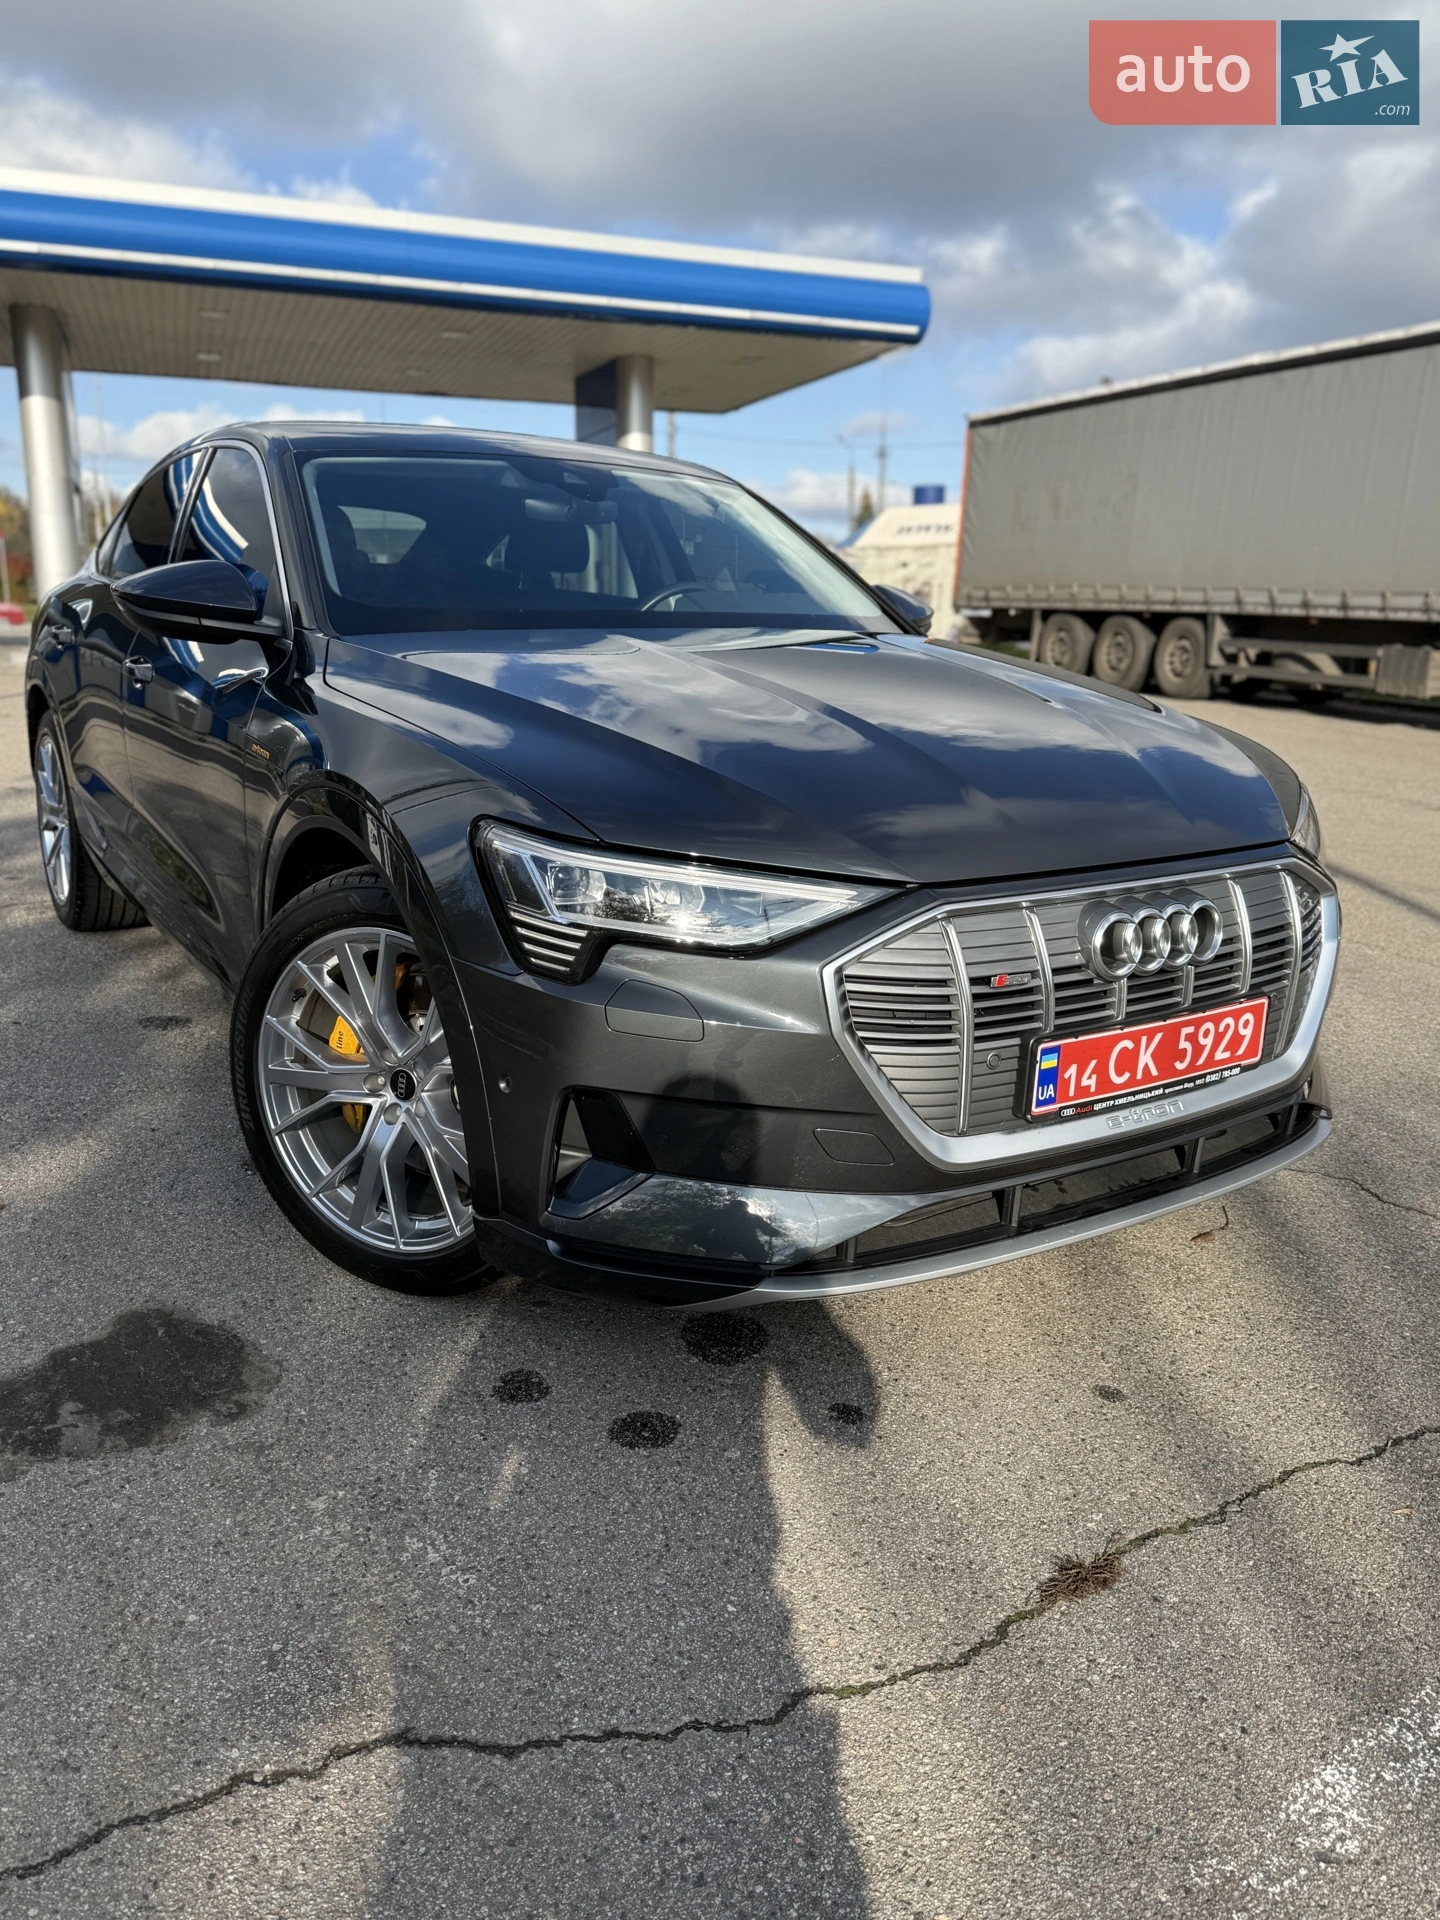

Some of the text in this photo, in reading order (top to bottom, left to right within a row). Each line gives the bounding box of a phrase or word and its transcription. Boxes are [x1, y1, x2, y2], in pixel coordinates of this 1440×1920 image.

[336, 1030, 344, 1049] line
[234, 985, 256, 1131] BRIDGESTONE
[1063, 1012, 1254, 1097] 14 CK 5929
[1038, 1084, 1055, 1100] UA
[1075, 1105, 1093, 1114] Audi
[1093, 1099, 1114, 1111] ЦЕНТР
[1114, 1088, 1163, 1106] ХМЕЛЬНИЦЬКИЙ
[1106, 1099, 1184, 1129] e-tron
